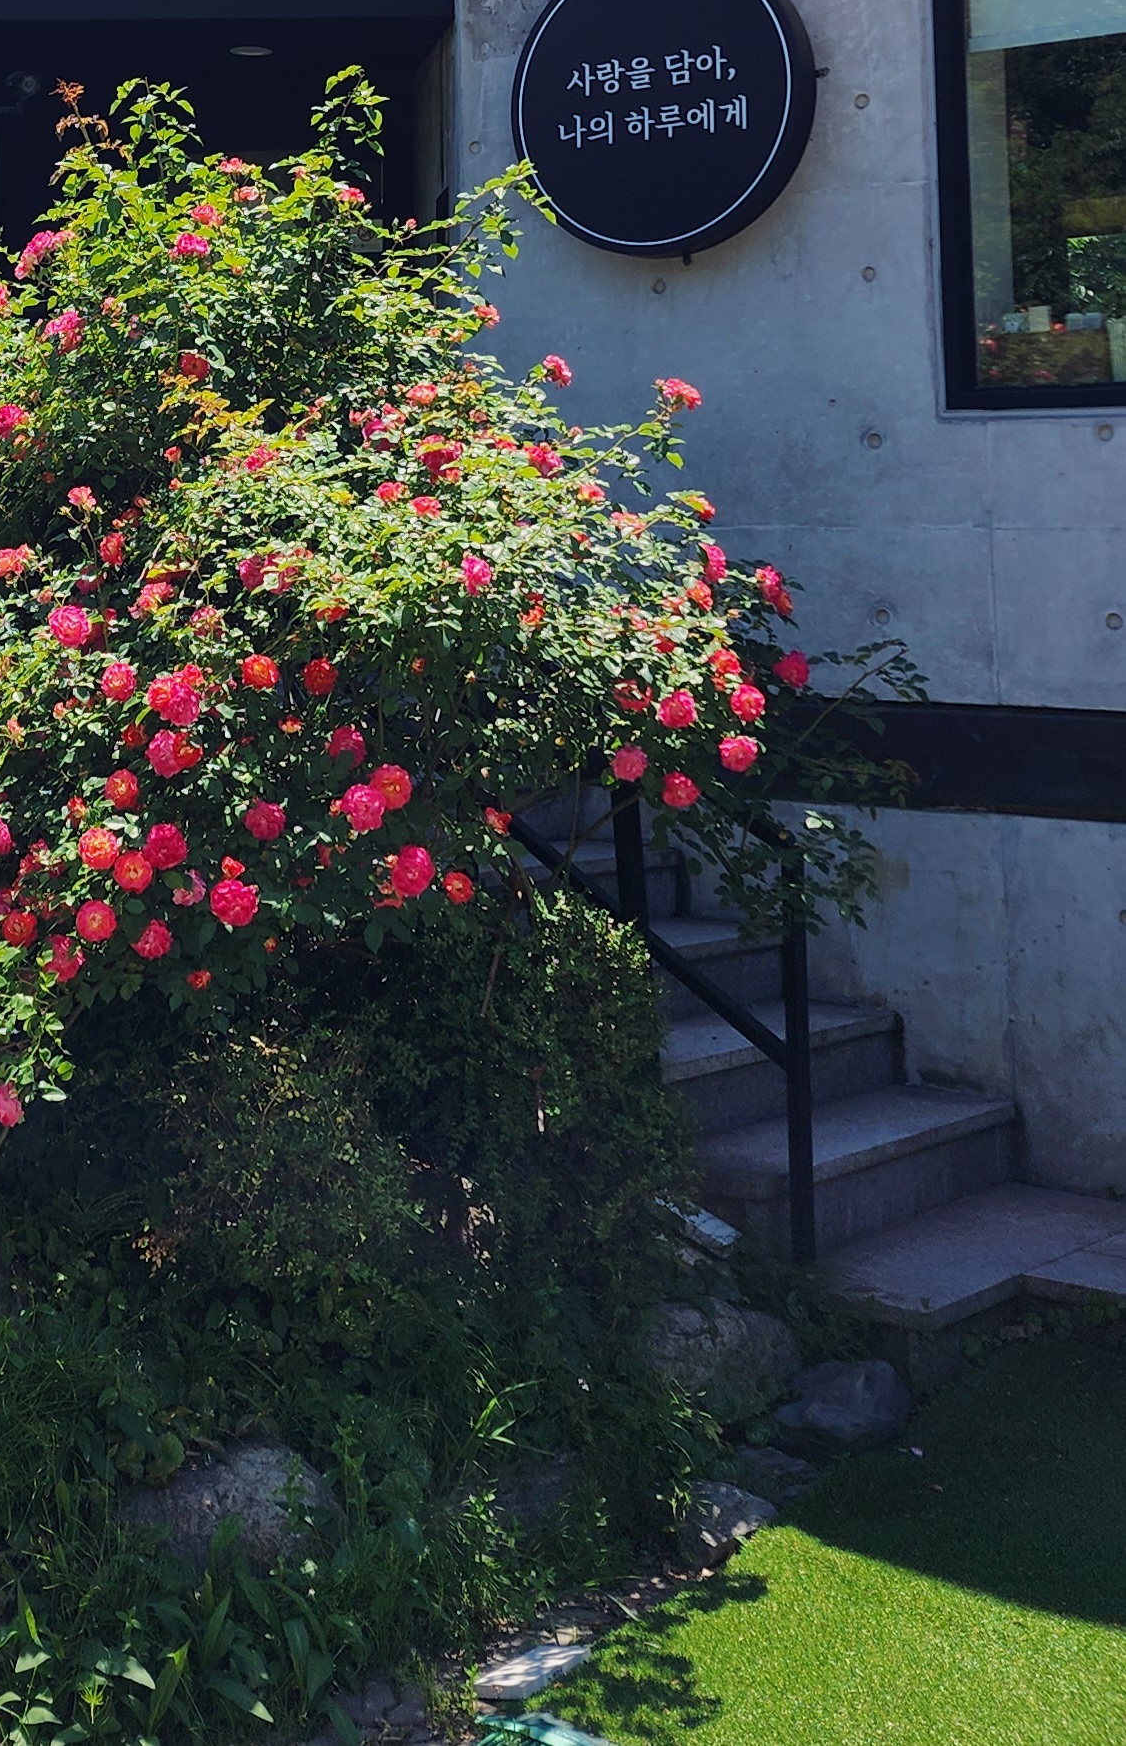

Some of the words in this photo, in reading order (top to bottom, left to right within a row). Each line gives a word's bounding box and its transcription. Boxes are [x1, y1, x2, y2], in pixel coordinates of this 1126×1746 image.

[566, 57, 656, 97] 사랑을
[664, 45, 737, 86] 담아,
[557, 110, 614, 149] 나의
[623, 94, 748, 141] 하루에게
